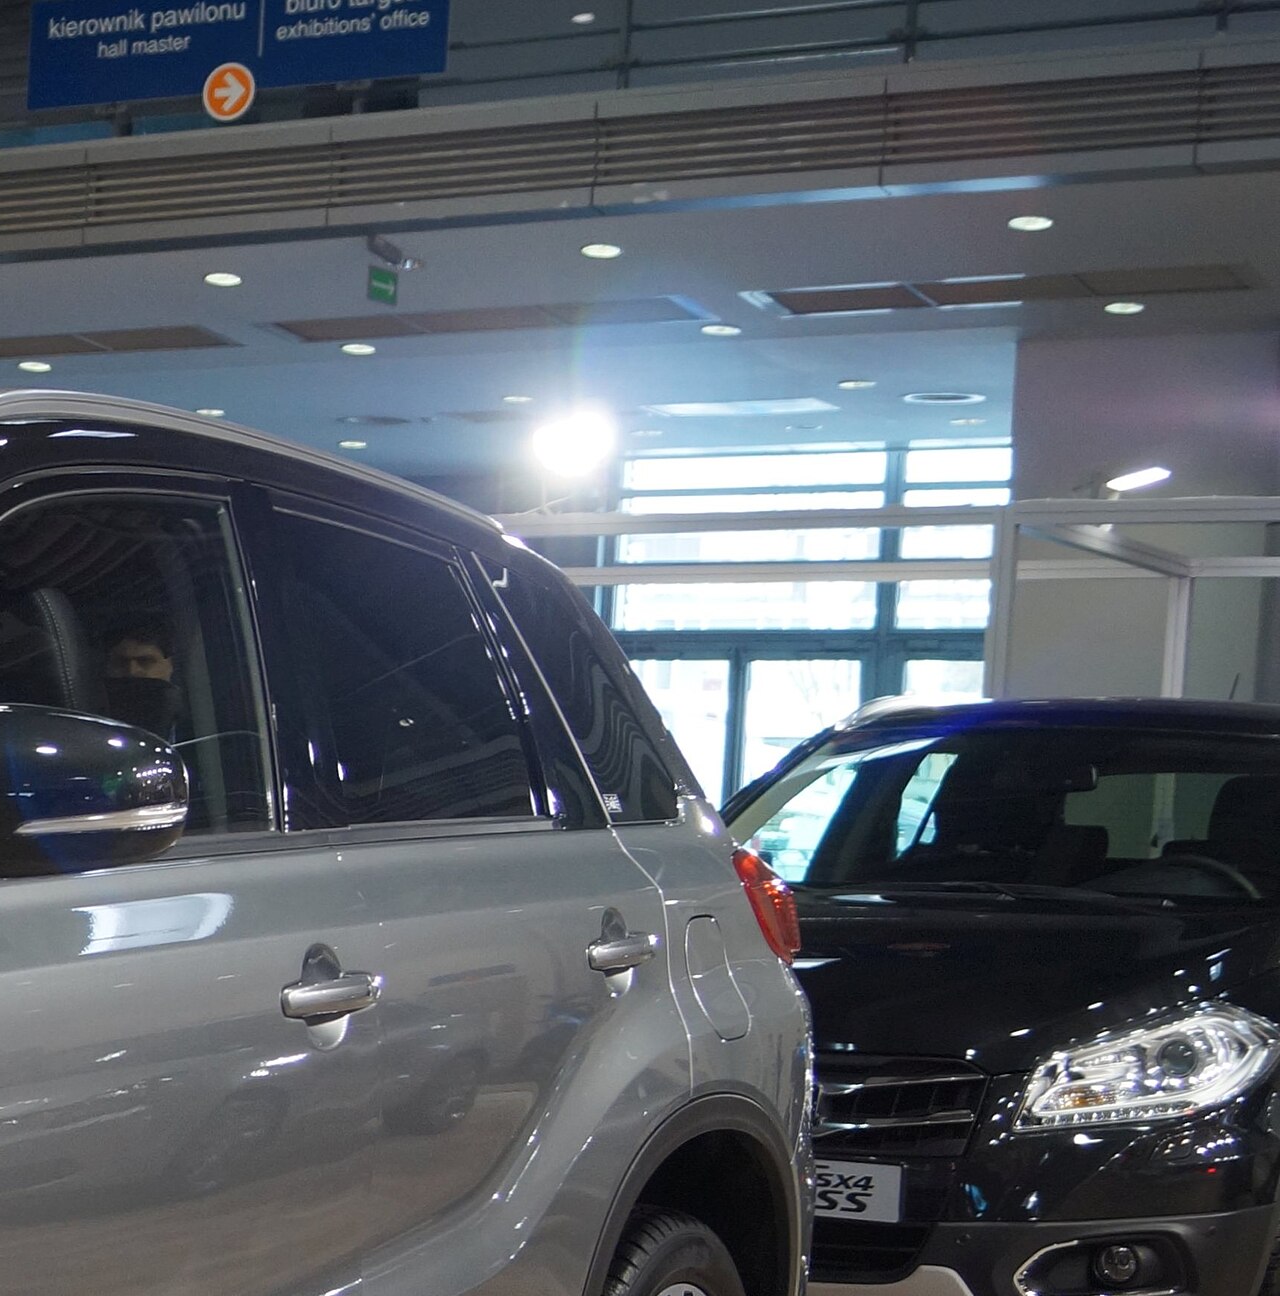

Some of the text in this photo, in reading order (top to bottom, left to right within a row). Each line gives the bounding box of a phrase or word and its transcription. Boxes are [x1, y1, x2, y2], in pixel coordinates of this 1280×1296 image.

[48, 2, 246, 38] kierownik pawilonu
[276, 9, 429, 40] exhibitions' office
[97, 35, 191, 58] hall master
[816, 1173, 874, 1191] SX4
